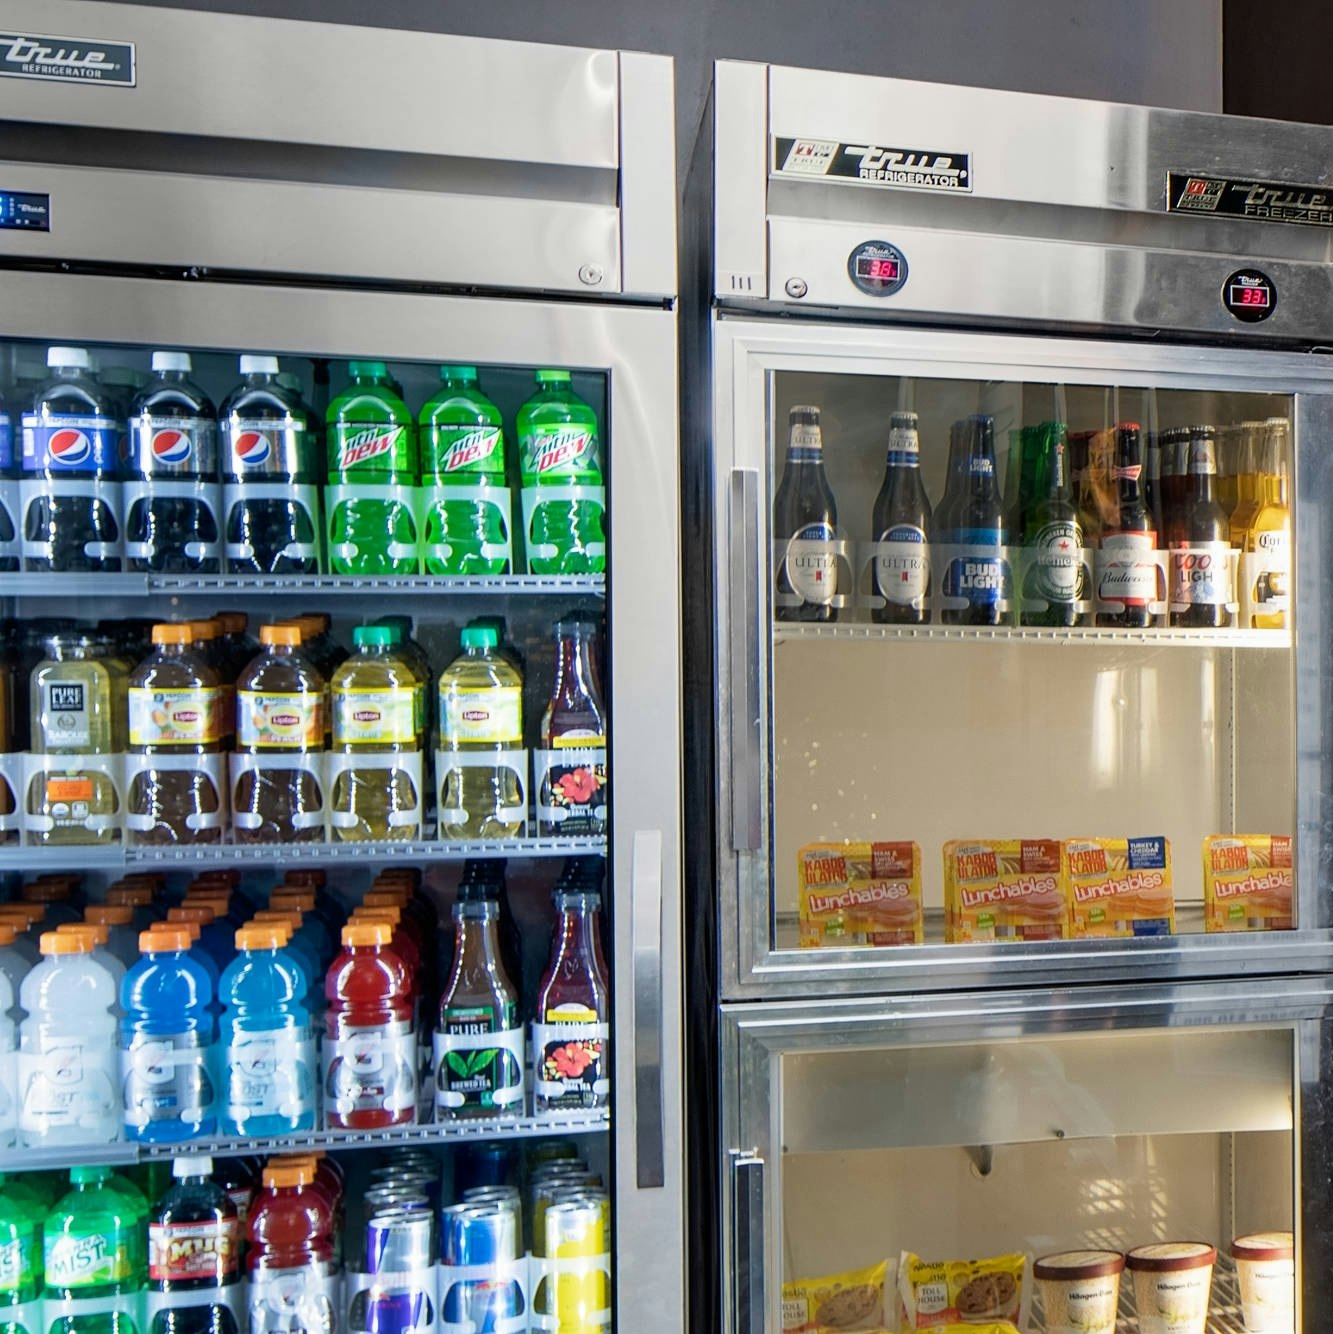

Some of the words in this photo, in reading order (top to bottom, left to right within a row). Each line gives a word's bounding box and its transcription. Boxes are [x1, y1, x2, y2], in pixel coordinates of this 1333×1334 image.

[22, 63, 102, 78] REFRIGERATOR
[859, 168, 959, 187] REFRIGERATOR
[1244, 205, 1333, 222] FREEZER
[964, 562, 1000, 576] BUD
[959, 574, 1007, 589] LIGHT
[273, 715, 299, 726] Lipton
[354, 711, 380, 721] Lipton
[462, 711, 489, 721] Lipton
[961, 877, 1057, 907] Lunchables
[1073, 871, 1164, 902] Lunchables
[1215, 872, 1293, 899] Lunchable
[809, 881, 910, 913] Lunchables
[450, 1022, 489, 1036] PURE
[171, 1236, 230, 1262] MUG
[52, 1244, 103, 1276] MIST
